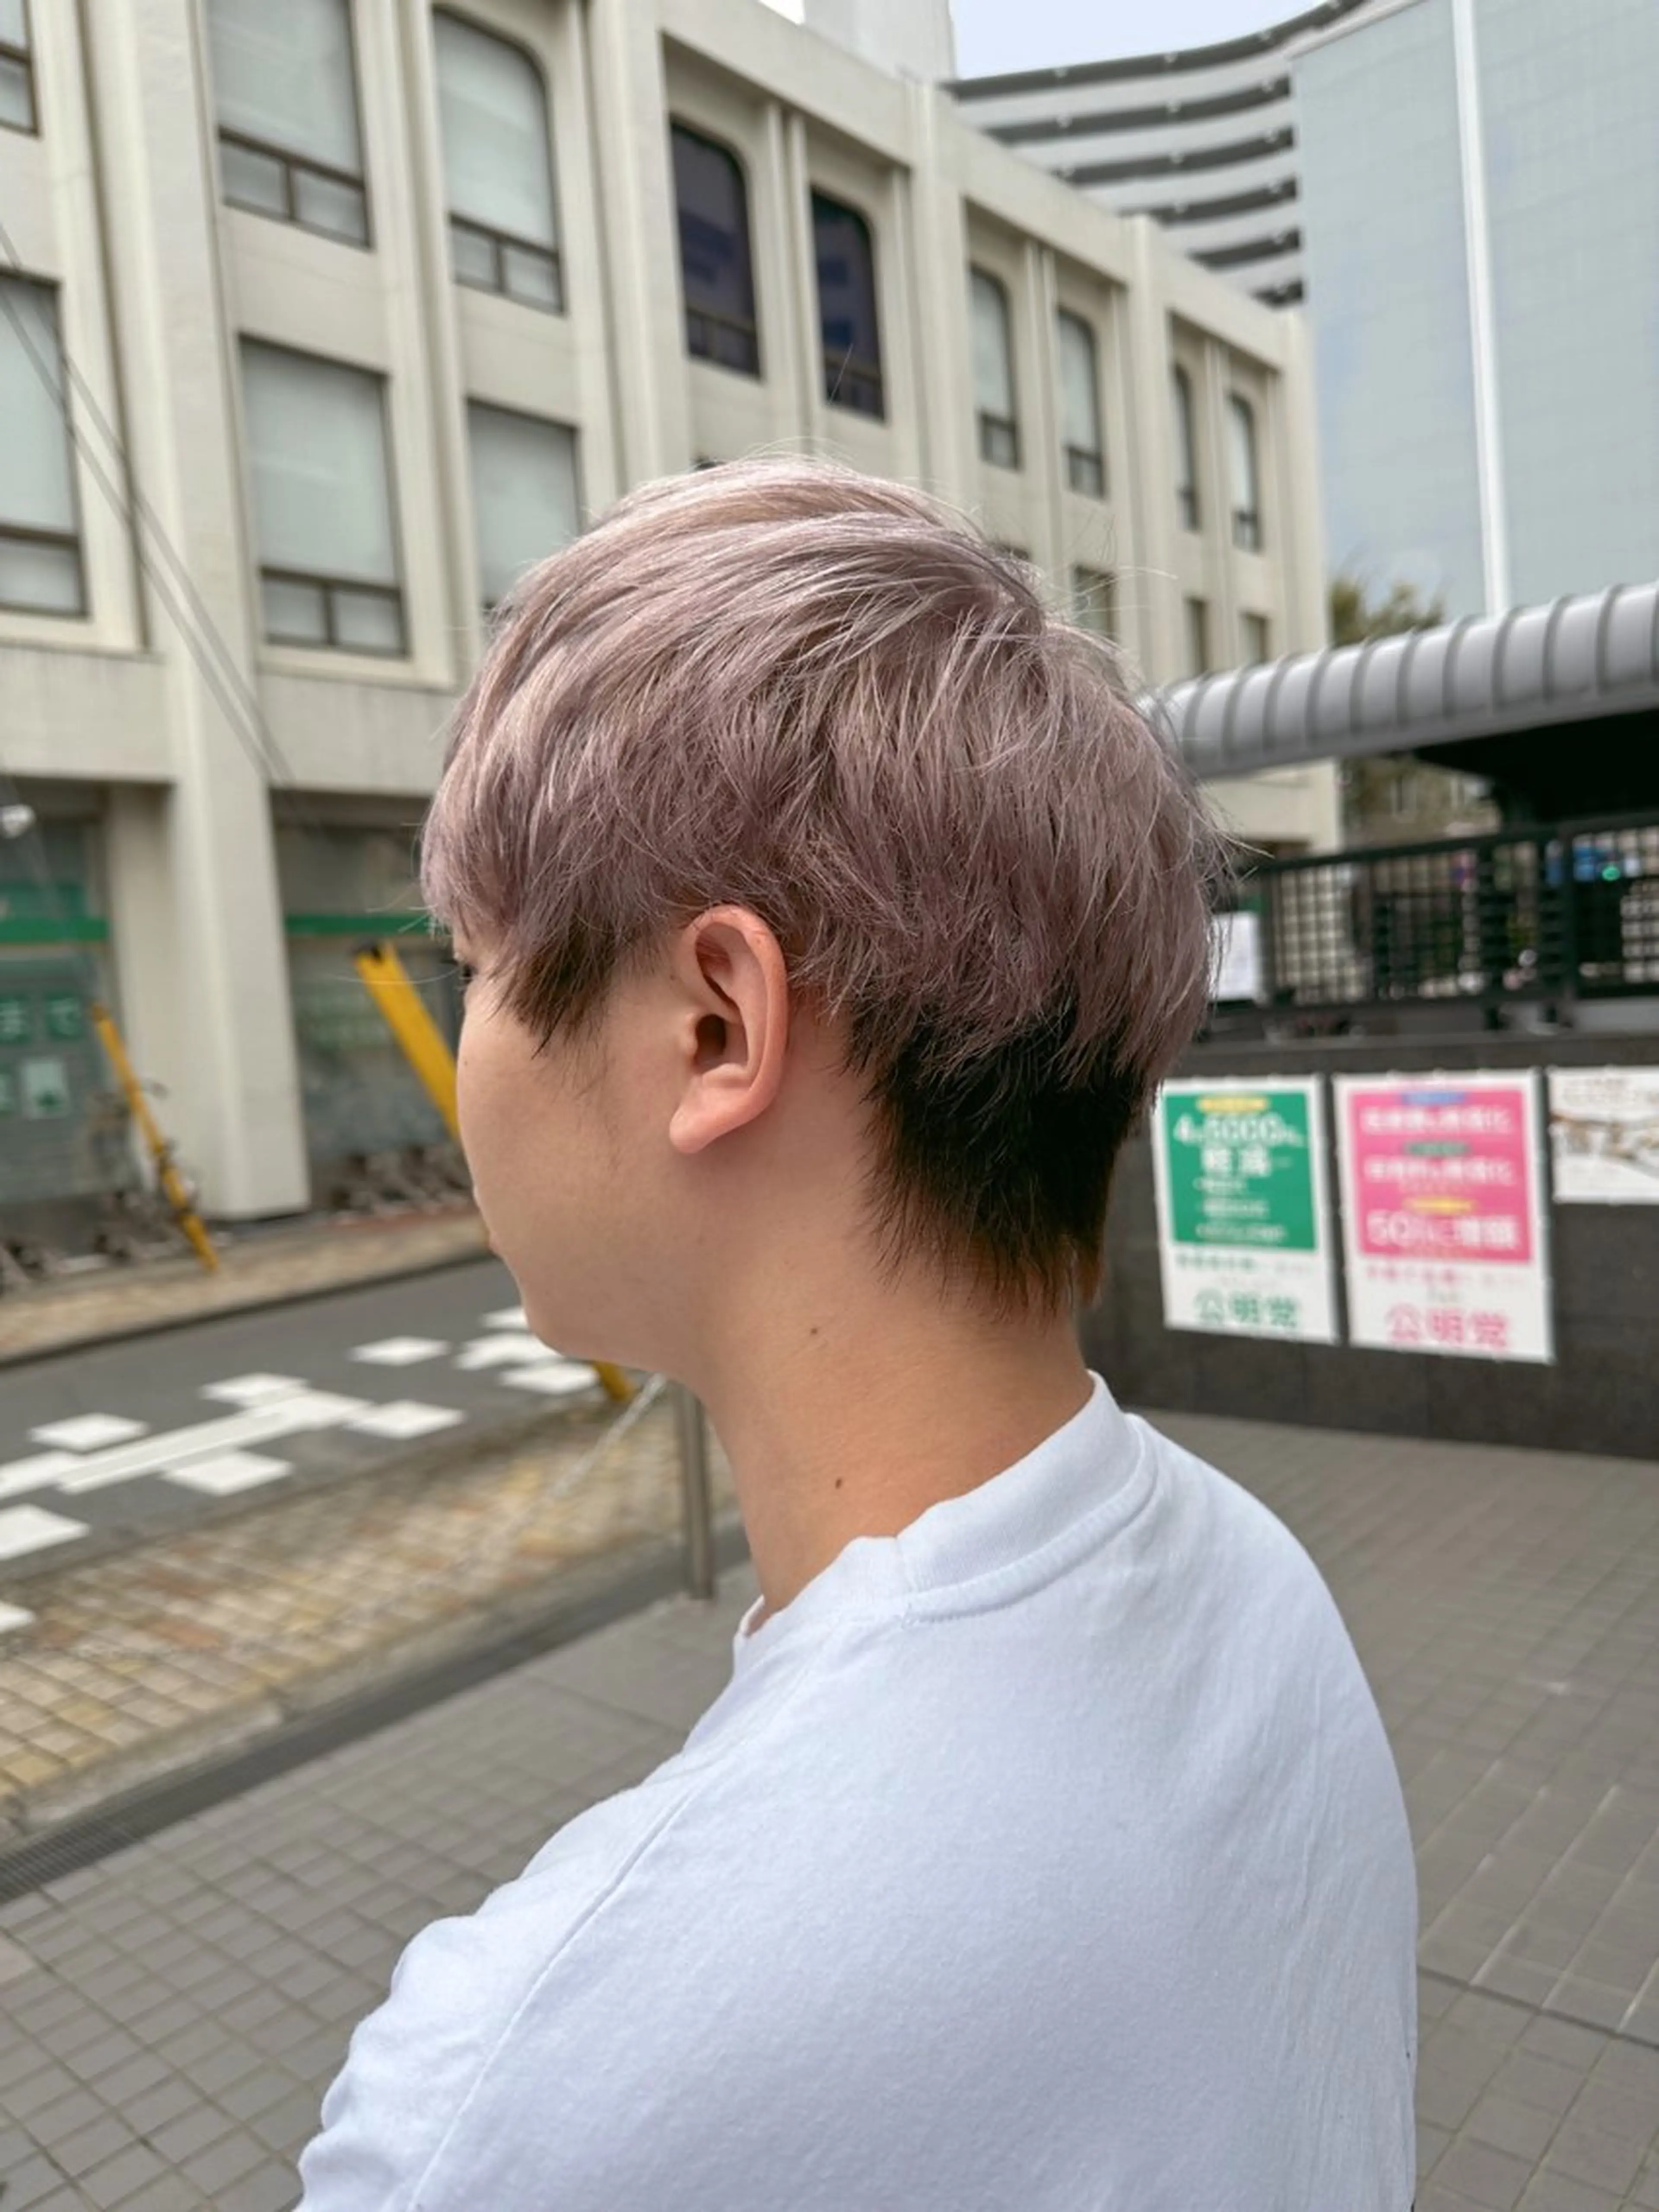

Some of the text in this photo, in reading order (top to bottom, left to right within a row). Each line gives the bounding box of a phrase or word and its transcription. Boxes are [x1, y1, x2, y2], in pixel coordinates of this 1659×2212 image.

[1194, 1289, 1299, 1330] 公明党
[1385, 1303, 1508, 1349] 公明党
